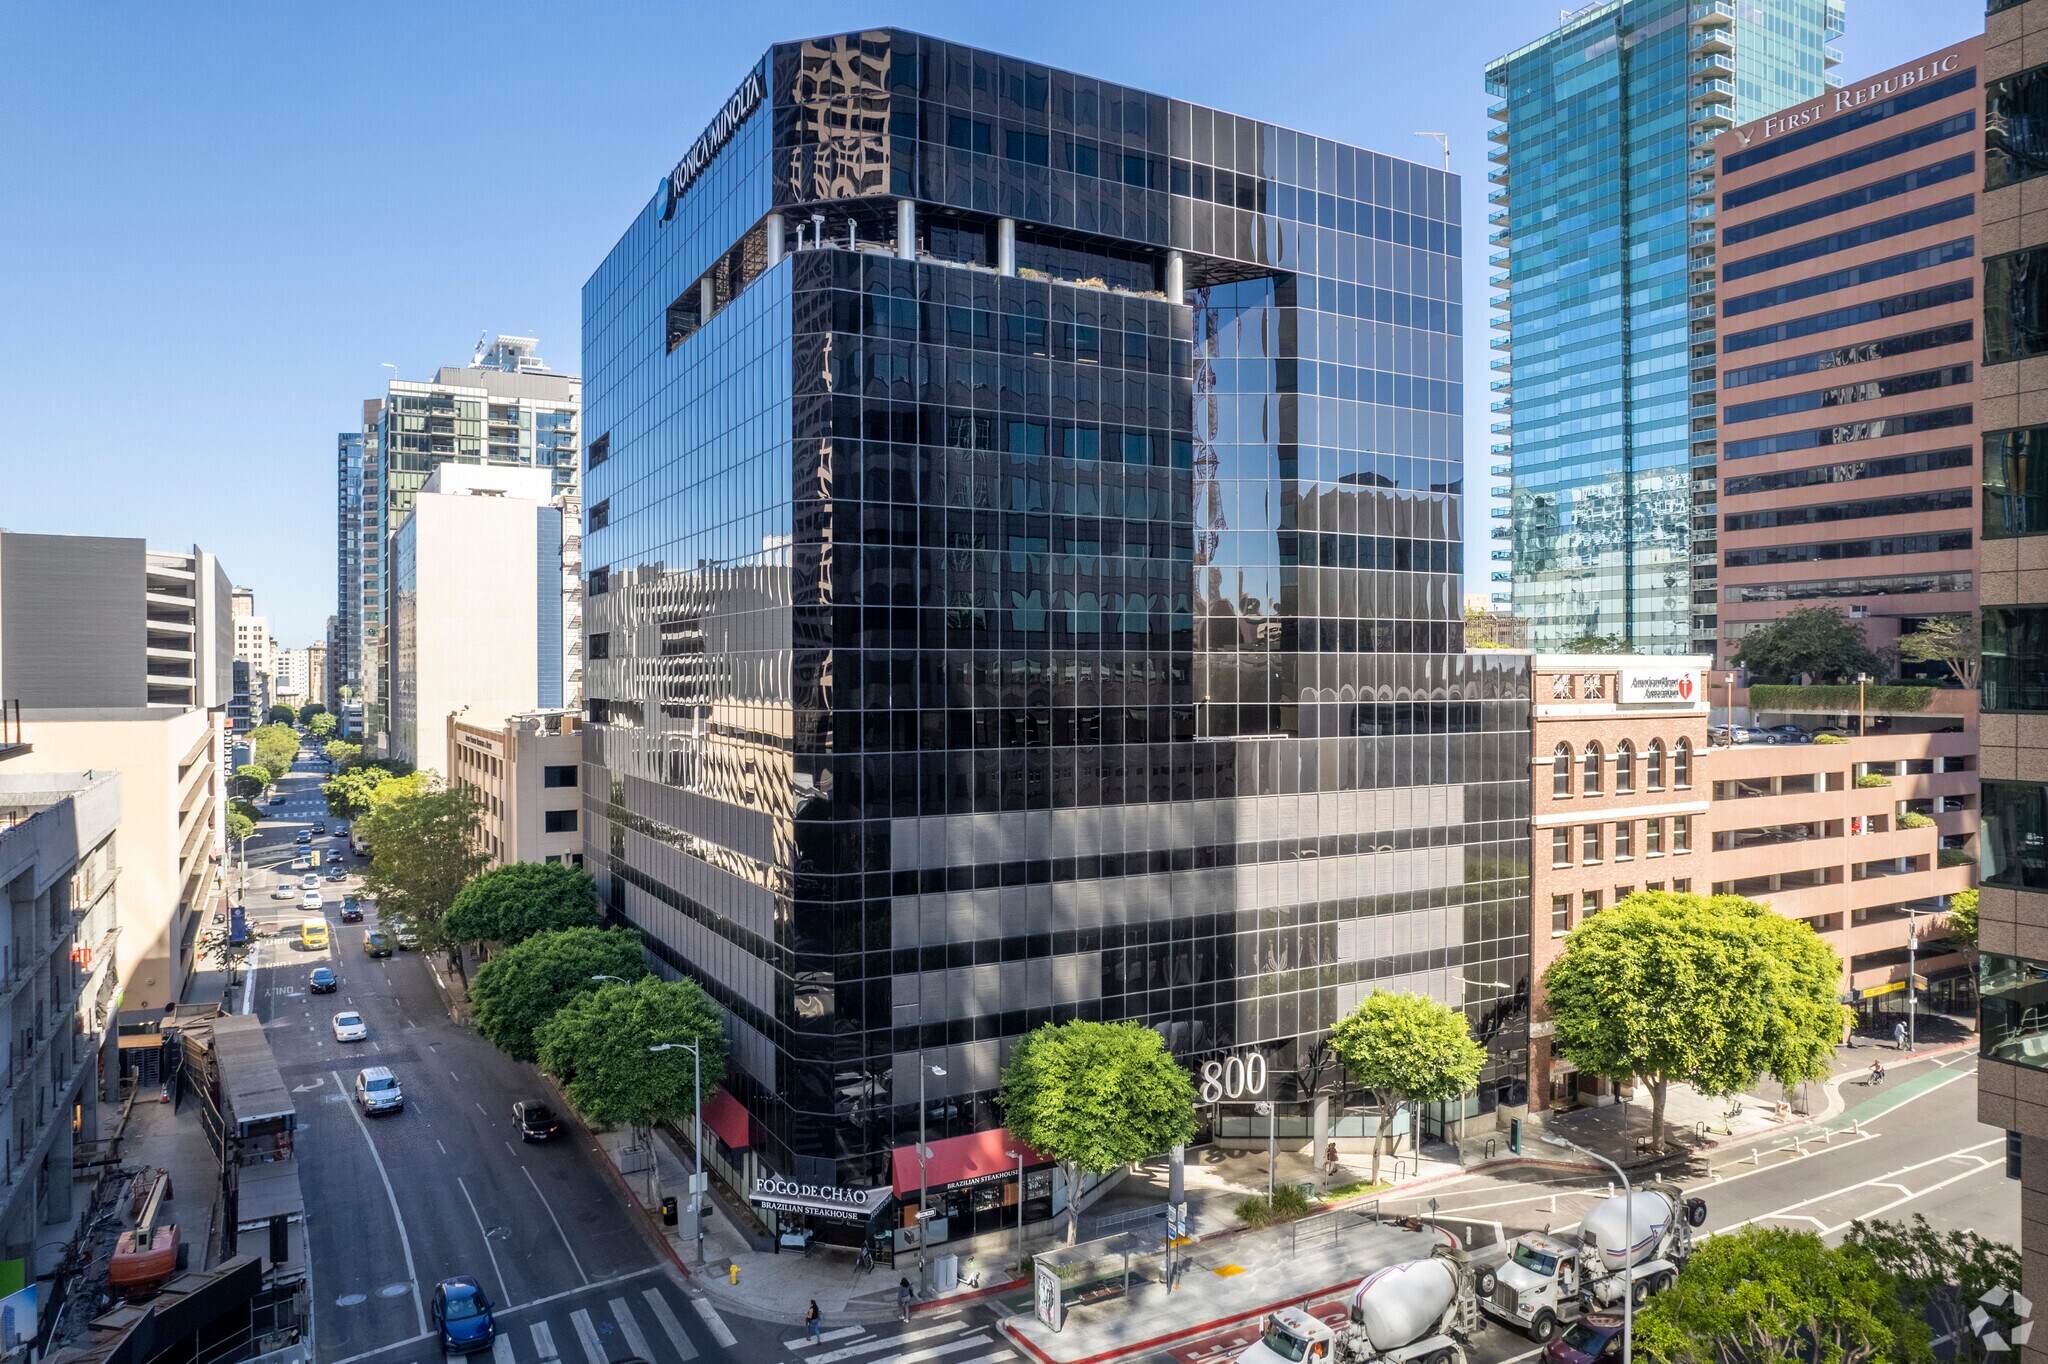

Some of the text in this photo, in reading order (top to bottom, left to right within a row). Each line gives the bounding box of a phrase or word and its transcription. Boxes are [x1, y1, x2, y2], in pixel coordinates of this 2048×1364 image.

[1764, 53, 1959, 139] FIRST REPUBLIC
[673, 74, 760, 197] KONICA MINOLTA
[224, 728, 233, 776] PARKING
[1200, 1053, 1266, 1103] 800
[756, 1178, 867, 1204] FOGO DE CHÃO
[947, 1177, 980, 1189] BRAZILIAN
[761, 1201, 803, 1213] BRAZILIAN
[804, 1206, 858, 1220] STEAKHOUSE
